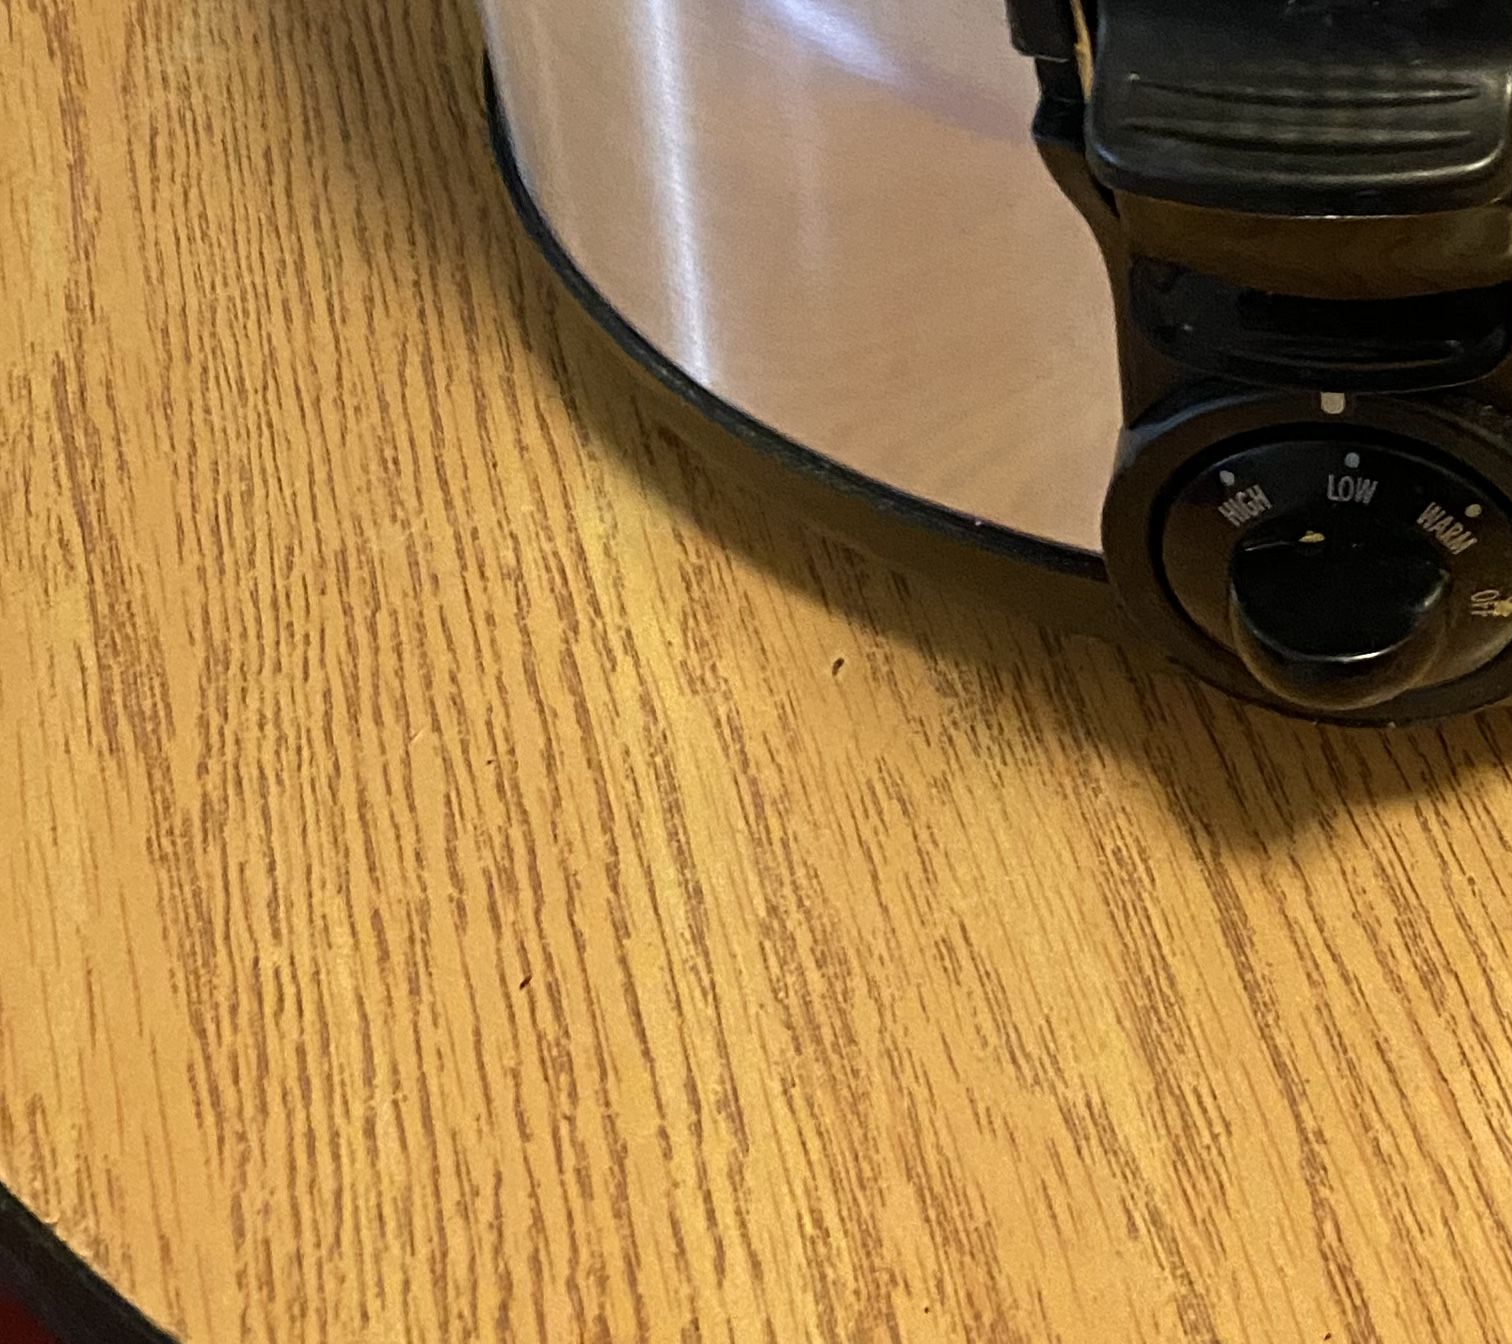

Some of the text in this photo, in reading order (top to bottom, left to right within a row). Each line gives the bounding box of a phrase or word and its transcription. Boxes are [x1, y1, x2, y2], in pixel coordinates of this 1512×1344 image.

[1217, 483, 1273, 528] HIGH
[1326, 473, 1379, 506] LOW
[1415, 501, 1479, 555] WARM
